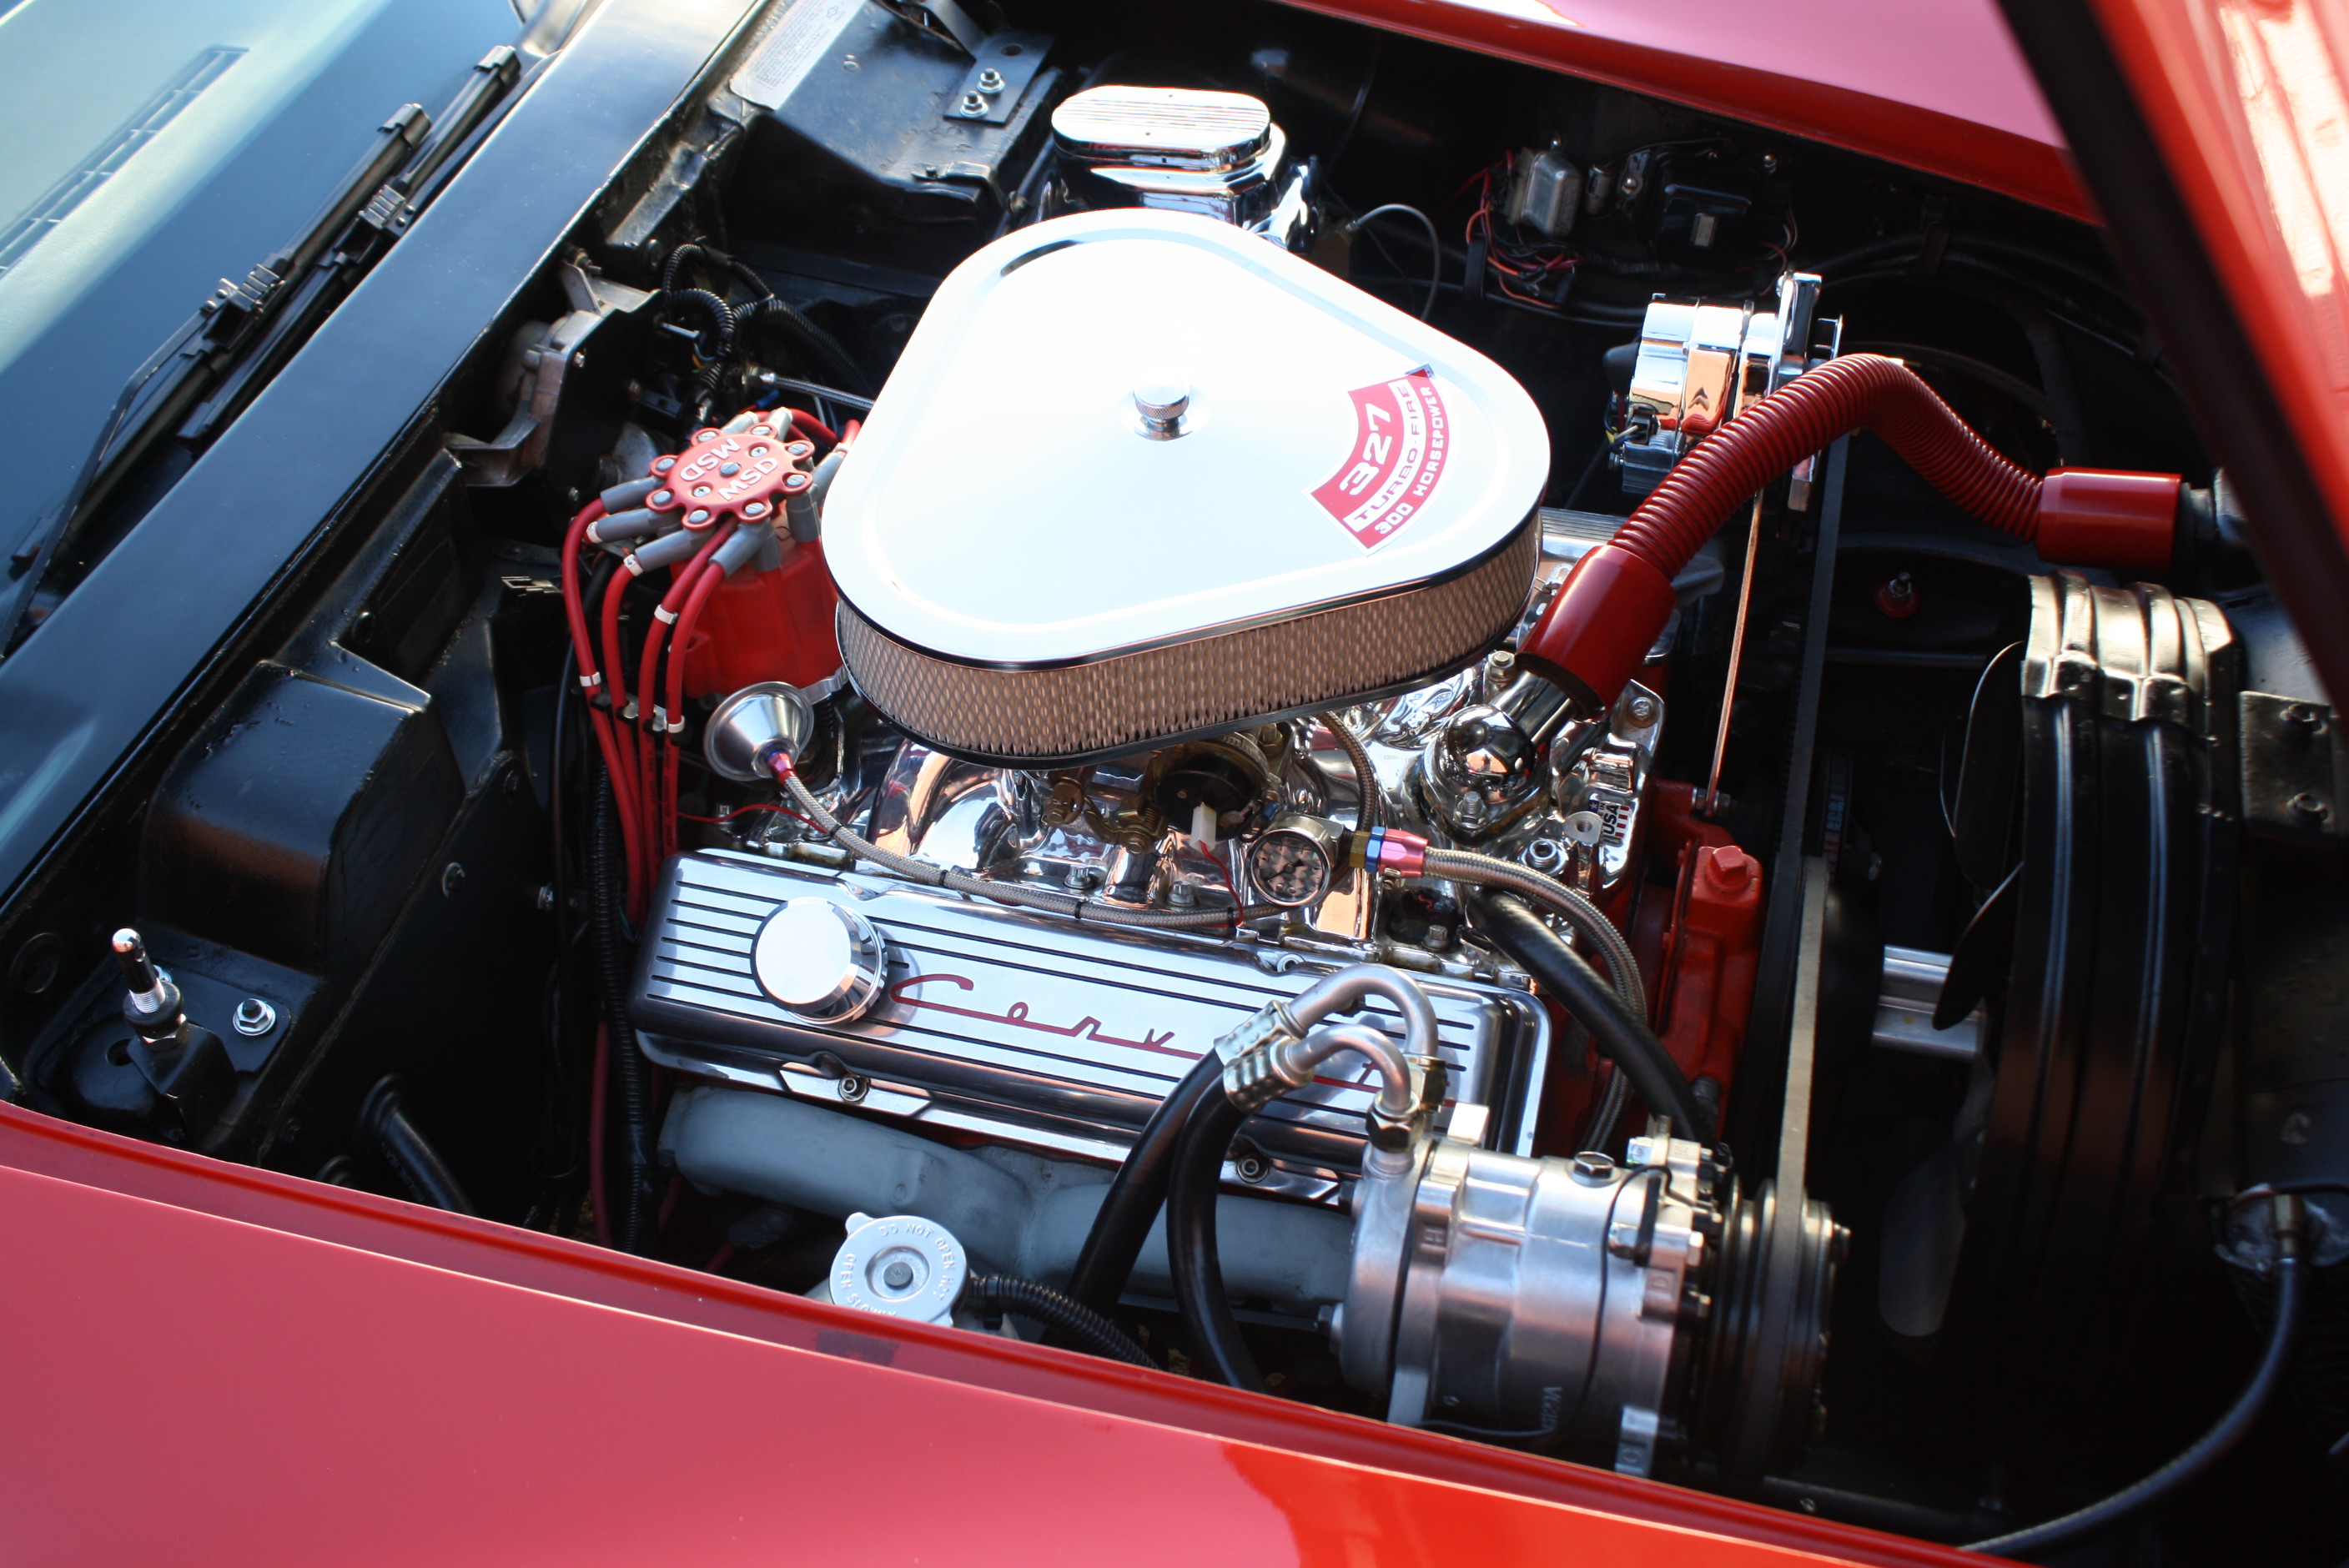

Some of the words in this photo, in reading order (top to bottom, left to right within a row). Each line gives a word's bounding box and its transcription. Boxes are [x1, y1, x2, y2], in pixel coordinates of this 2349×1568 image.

[680, 437, 742, 481] MSD
[1339, 403, 1393, 495] 327
[1374, 502, 1414, 535] 300
[1412, 386, 1445, 497] HORSEPOWER
[717, 457, 778, 501] MSD
[1602, 805, 1620, 835] USA
[878, 1224, 899, 1237] DO
[906, 1223, 934, 1239] NOT
[935, 1238, 957, 1270] OPEN
[840, 1253, 858, 1289] OPEN
